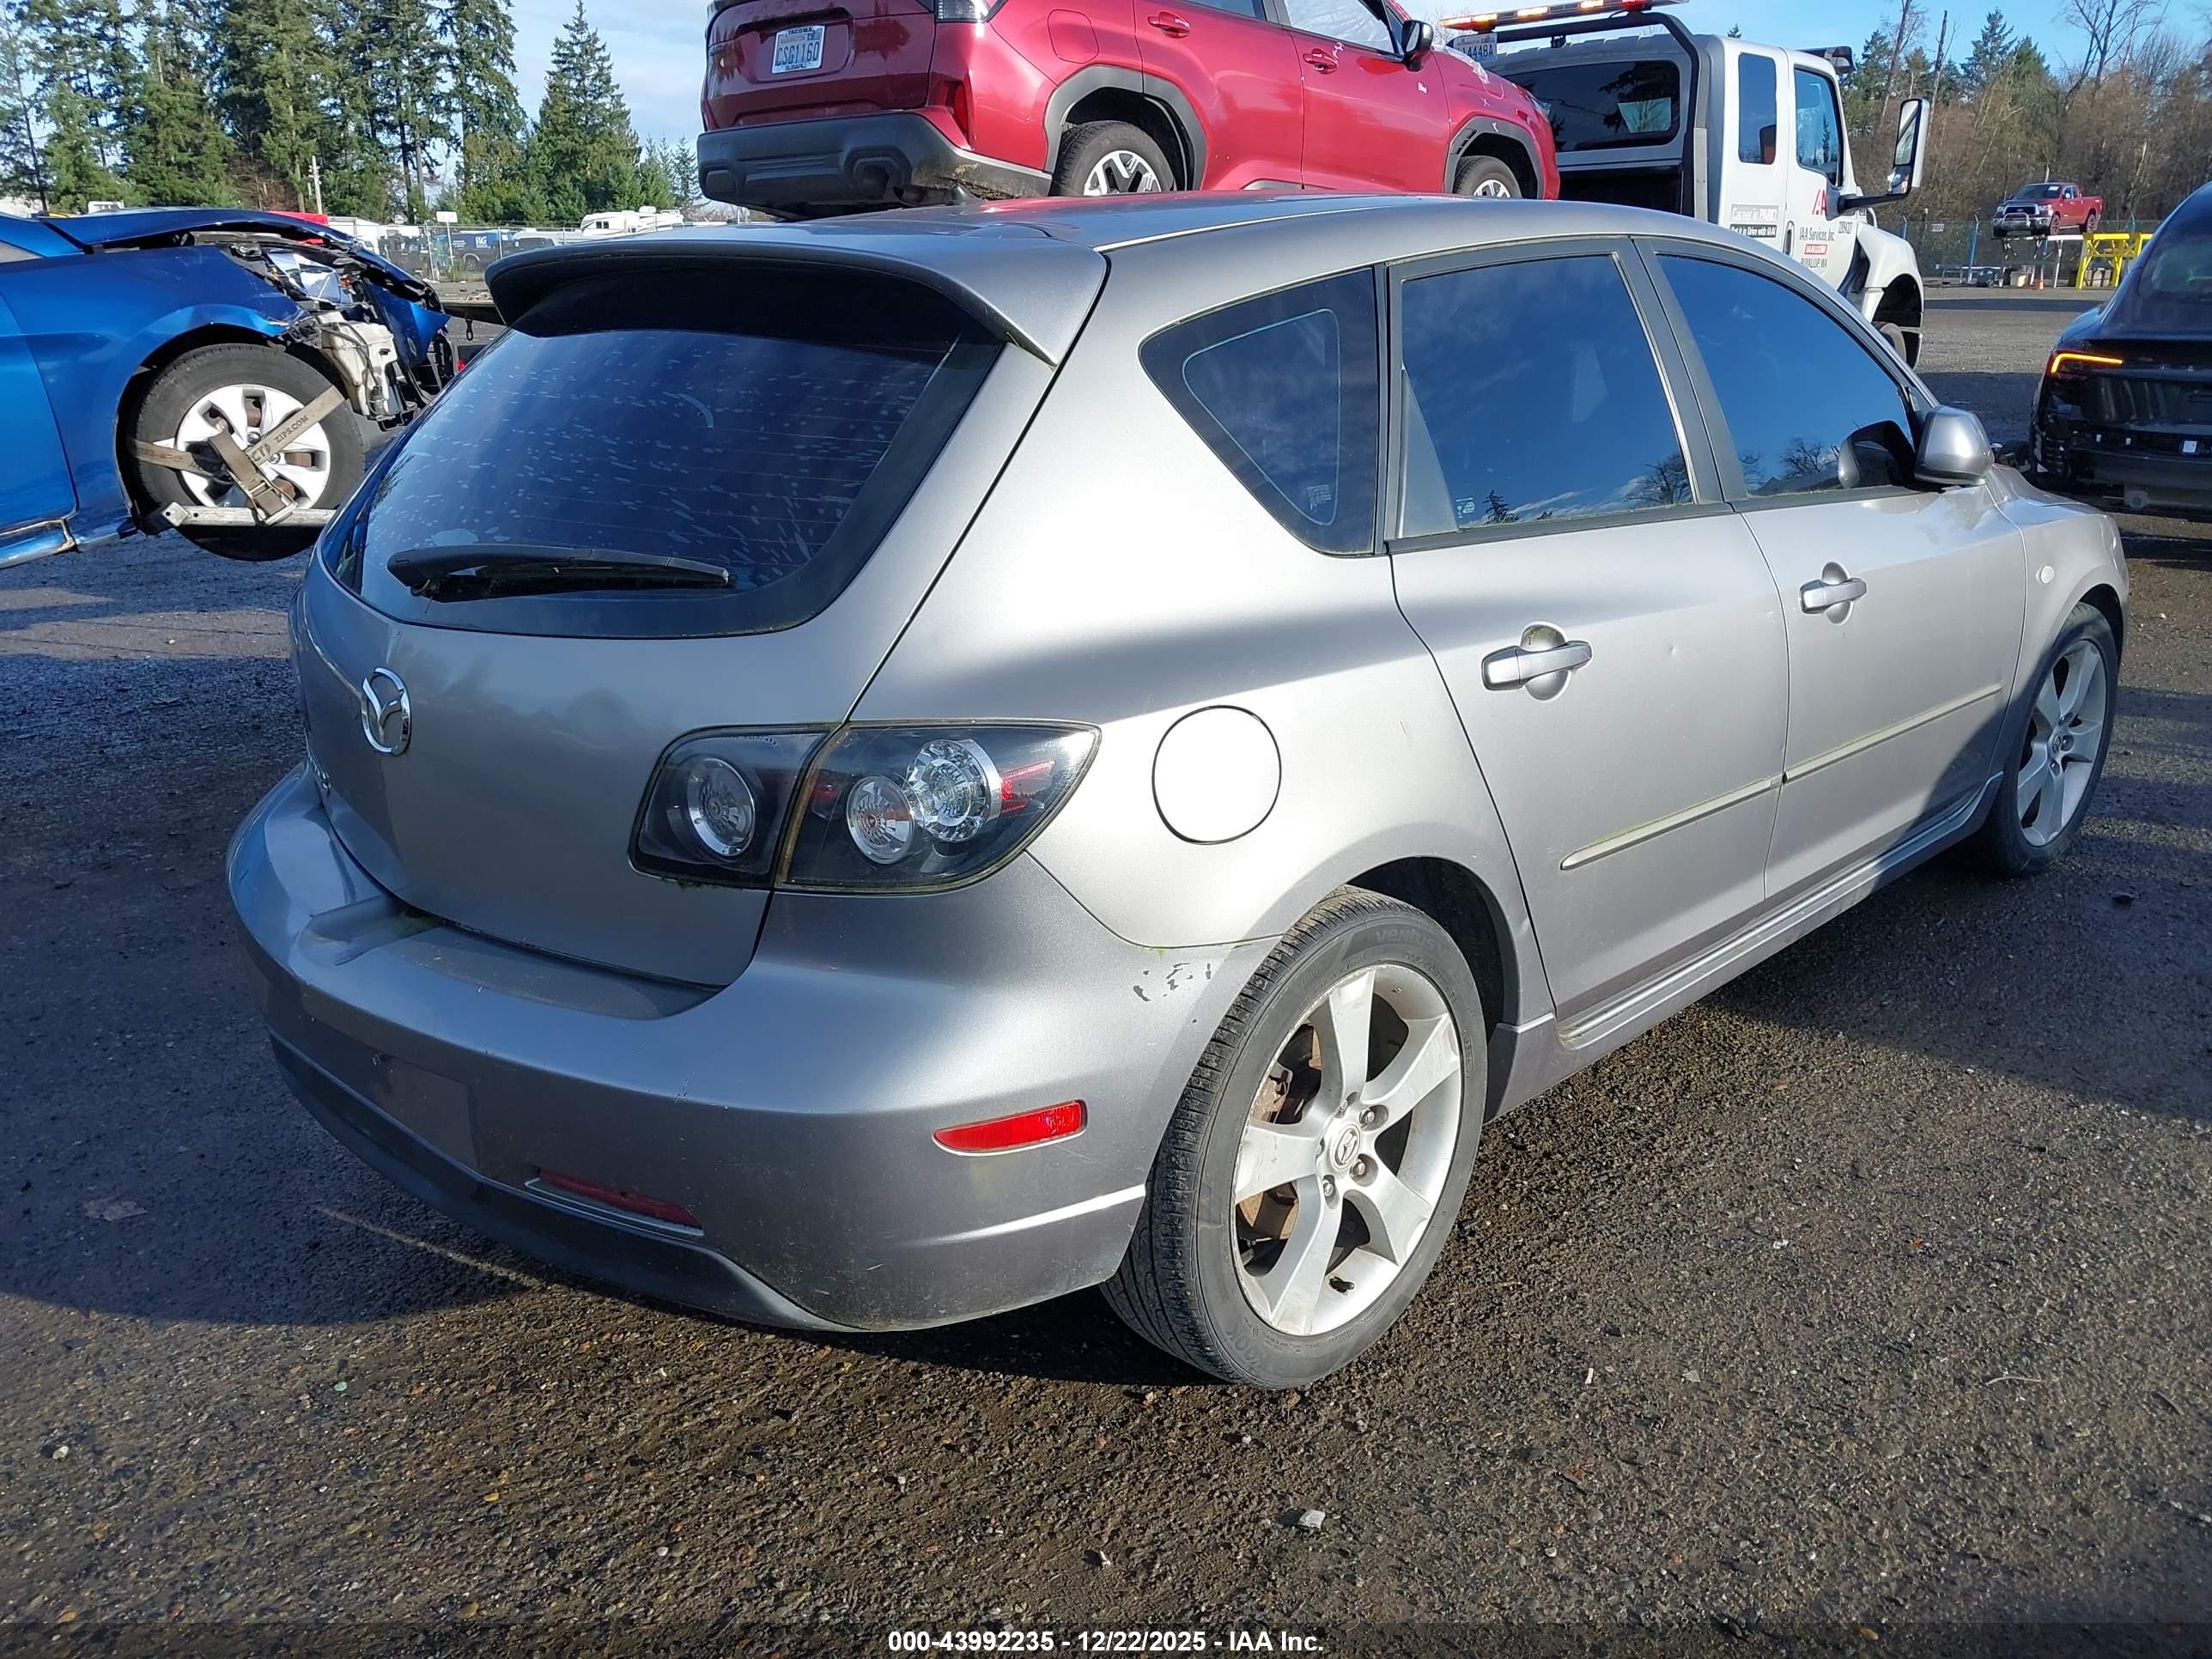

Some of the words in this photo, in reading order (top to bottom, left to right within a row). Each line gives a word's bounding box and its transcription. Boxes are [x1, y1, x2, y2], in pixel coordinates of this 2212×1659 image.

[787, 27, 812, 35] TACOMA
[775, 41, 820, 66] CSG1160
[1732, 207, 1752, 221] Career
[275, 416, 308, 443] ZIPS.COM
